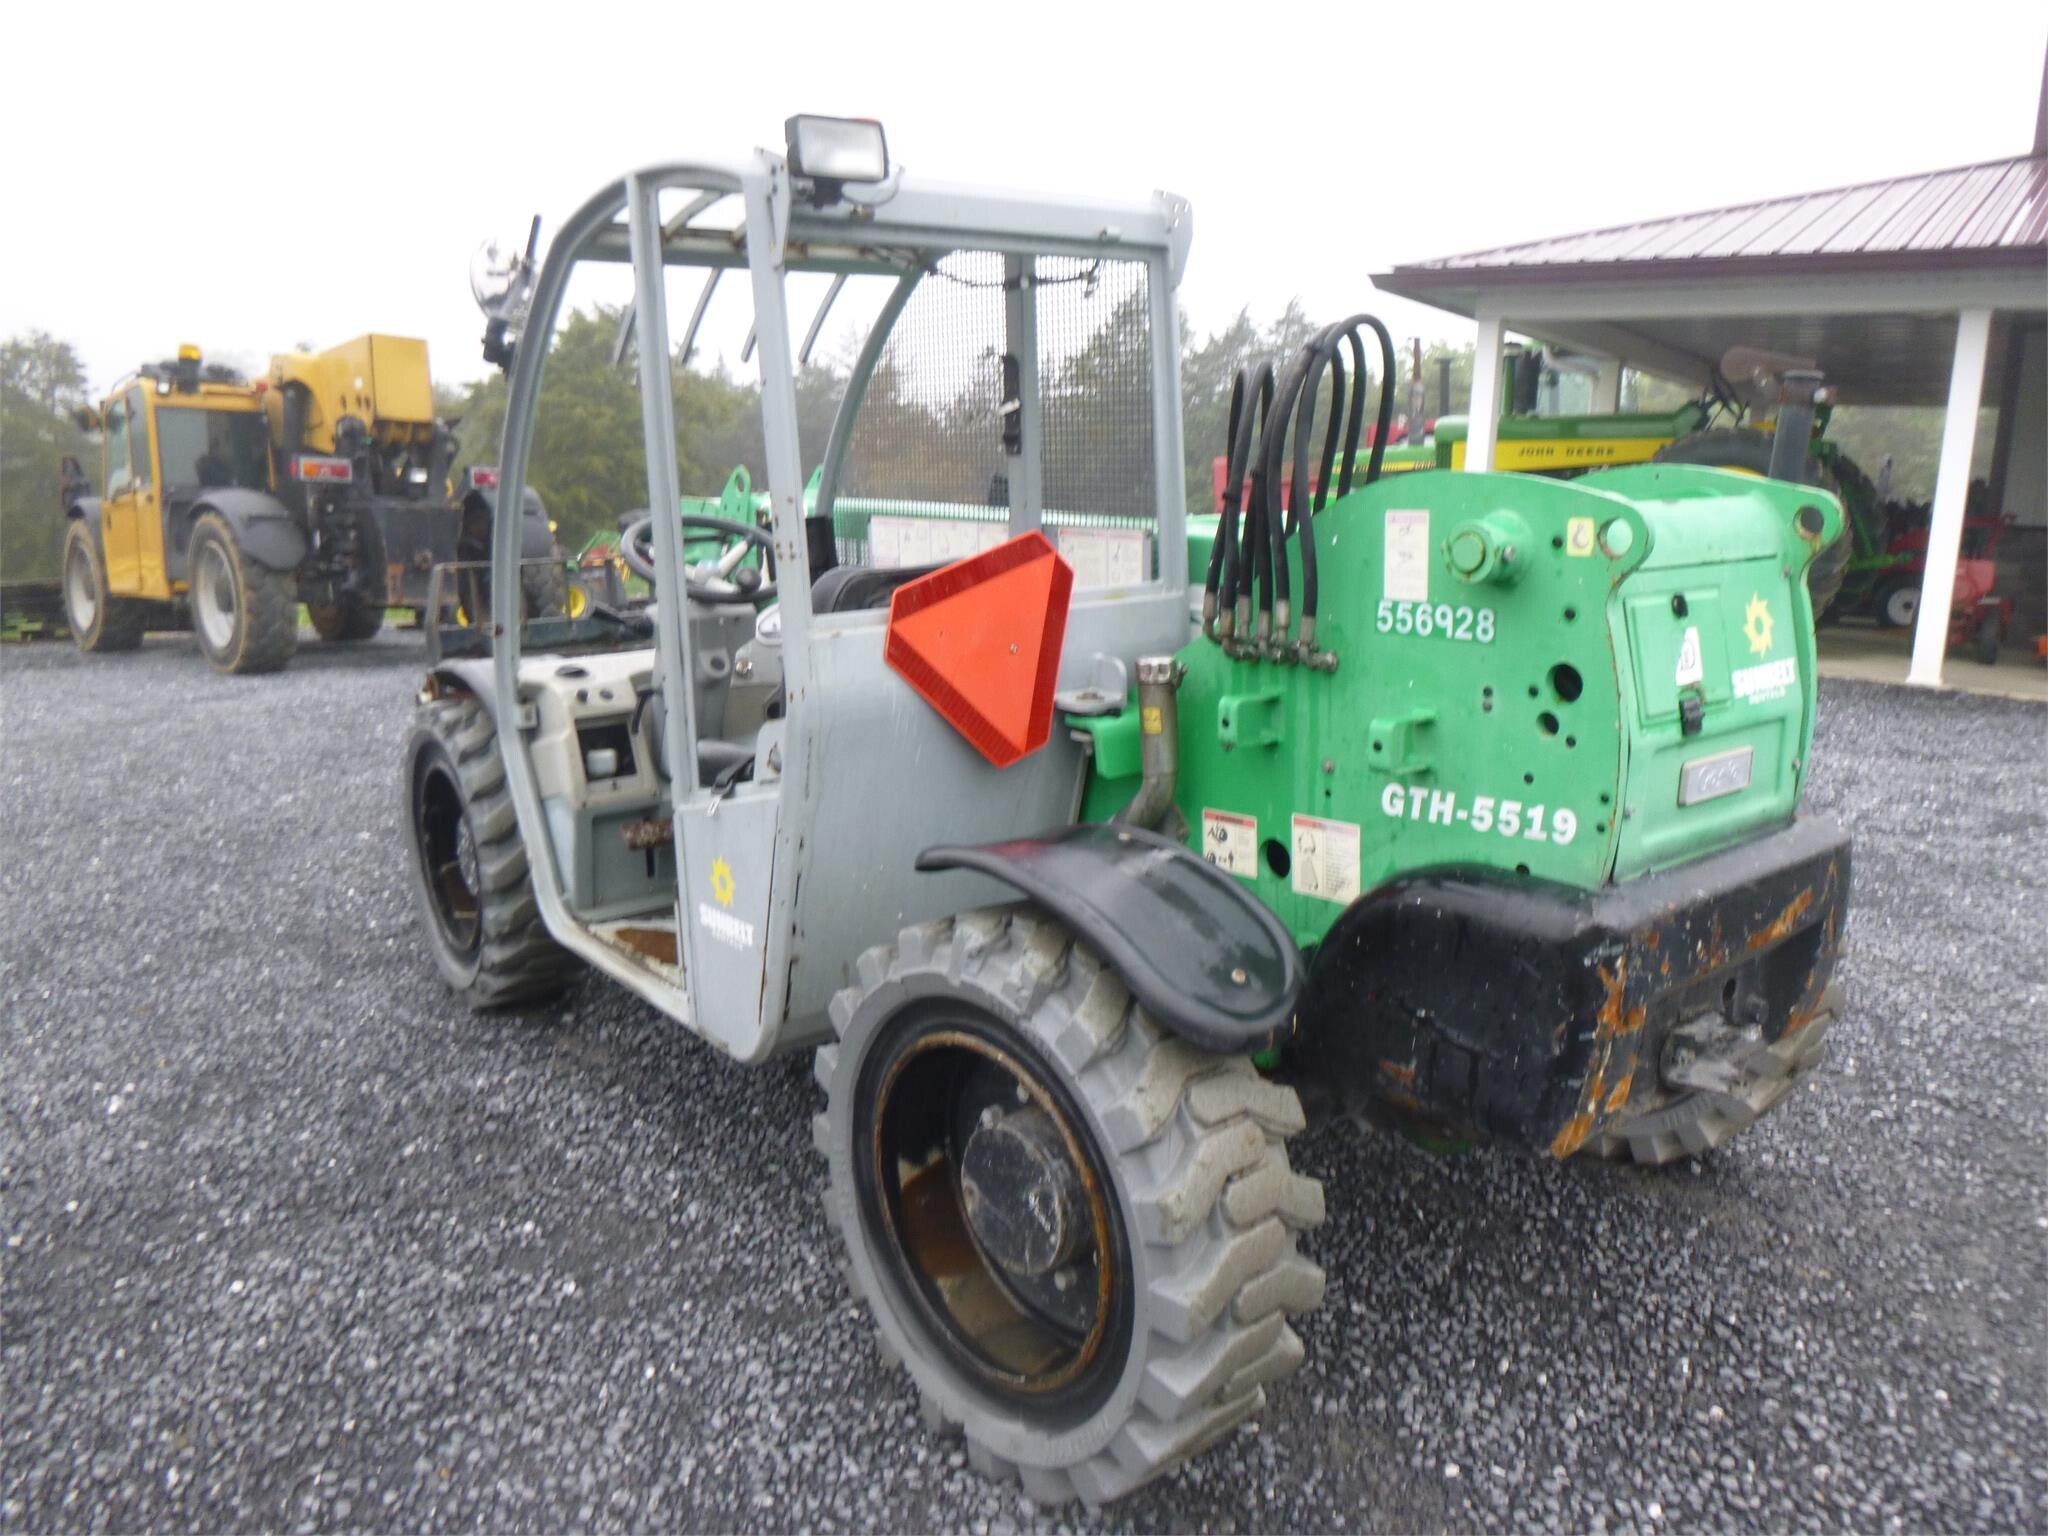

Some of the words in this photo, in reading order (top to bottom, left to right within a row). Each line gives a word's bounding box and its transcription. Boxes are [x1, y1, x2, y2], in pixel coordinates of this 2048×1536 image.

[1519, 446, 1555, 457] JOHN
[1565, 446, 1615, 457] DEERE
[1376, 600, 1495, 643] 556928
[1381, 782, 1577, 846] GTH-5519
